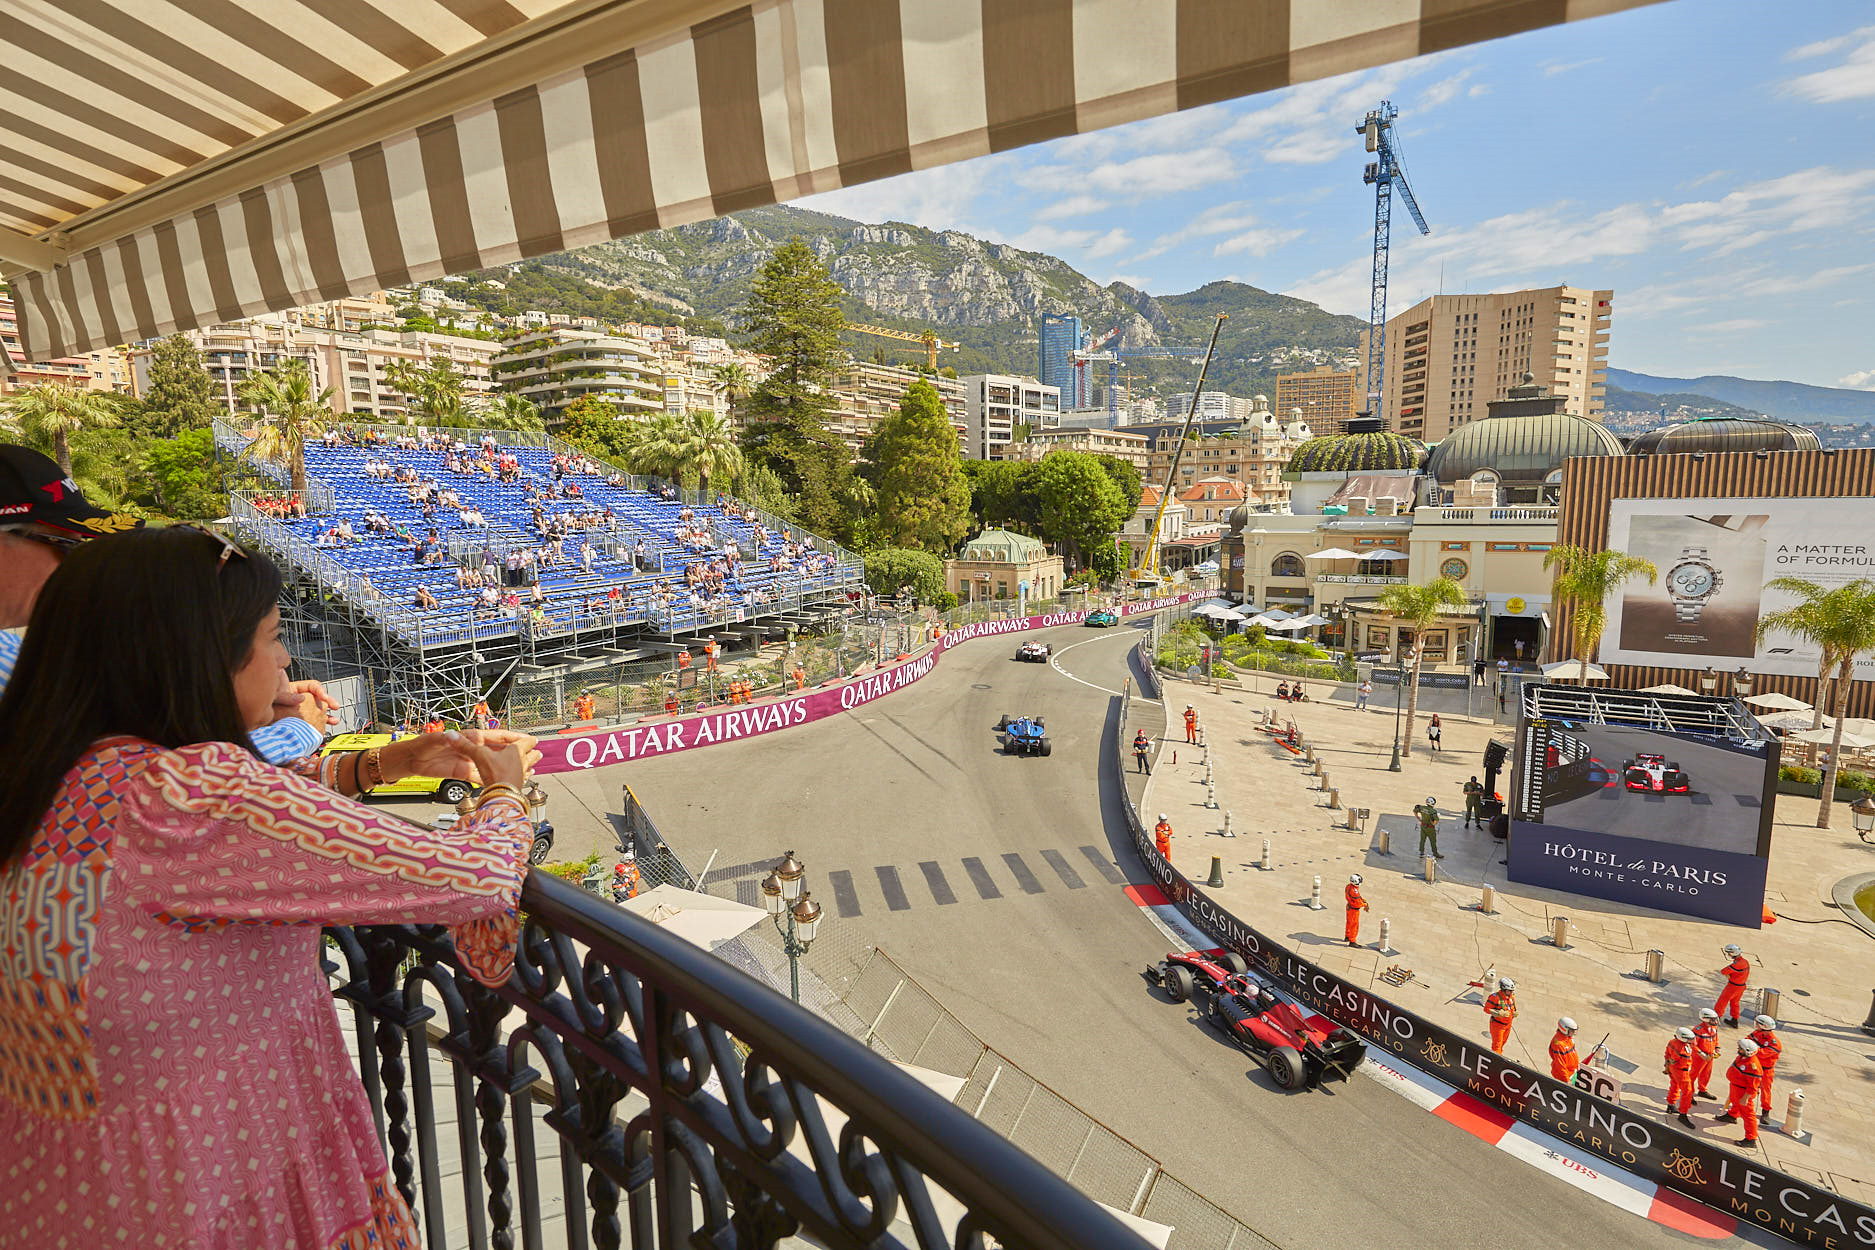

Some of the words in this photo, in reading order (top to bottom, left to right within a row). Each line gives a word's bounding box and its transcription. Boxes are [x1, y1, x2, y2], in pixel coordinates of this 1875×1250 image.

[1777, 556, 1800, 564] OF
[1806, 557, 1875, 565] FORMUL
[1796, 545, 1866, 554] MATTER
[1043, 611, 1078, 627] QATAR
[1128, 603, 1151, 614] QATAR
[1152, 596, 1180, 609] AIRWAYS
[943, 626, 976, 649] QATAR
[977, 618, 1030, 636] AIRWAYS
[841, 671, 891, 710] QATAR
[893, 652, 934, 690] AIRWAYS
[565, 723, 686, 768] QATAR
[694, 699, 807, 745] AIRWAYS
[1144, 842, 1173, 884] CASINO
[1544, 842, 1623, 868] HÔTEL
[1627, 859, 1647, 871] de
[1651, 861, 1727, 886] PARIS
[1186, 888, 1198, 910] LE
[1200, 901, 1259, 953] CASINO
[1287, 958, 1307, 985] LE
[1312, 975, 1414, 1039] CASINO
[1379, 1065, 1407, 1080] UBS
[1575, 1068, 1614, 1101] SC
[1460, 1046, 1492, 1080] LE
[1500, 1069, 1652, 1149] CASINO
[1561, 1158, 1598, 1180] UBS
[1719, 1159, 1766, 1200] LE
[1778, 1187, 1875, 1244] CAS
[1731, 1197, 1841, 1250] MONTE
